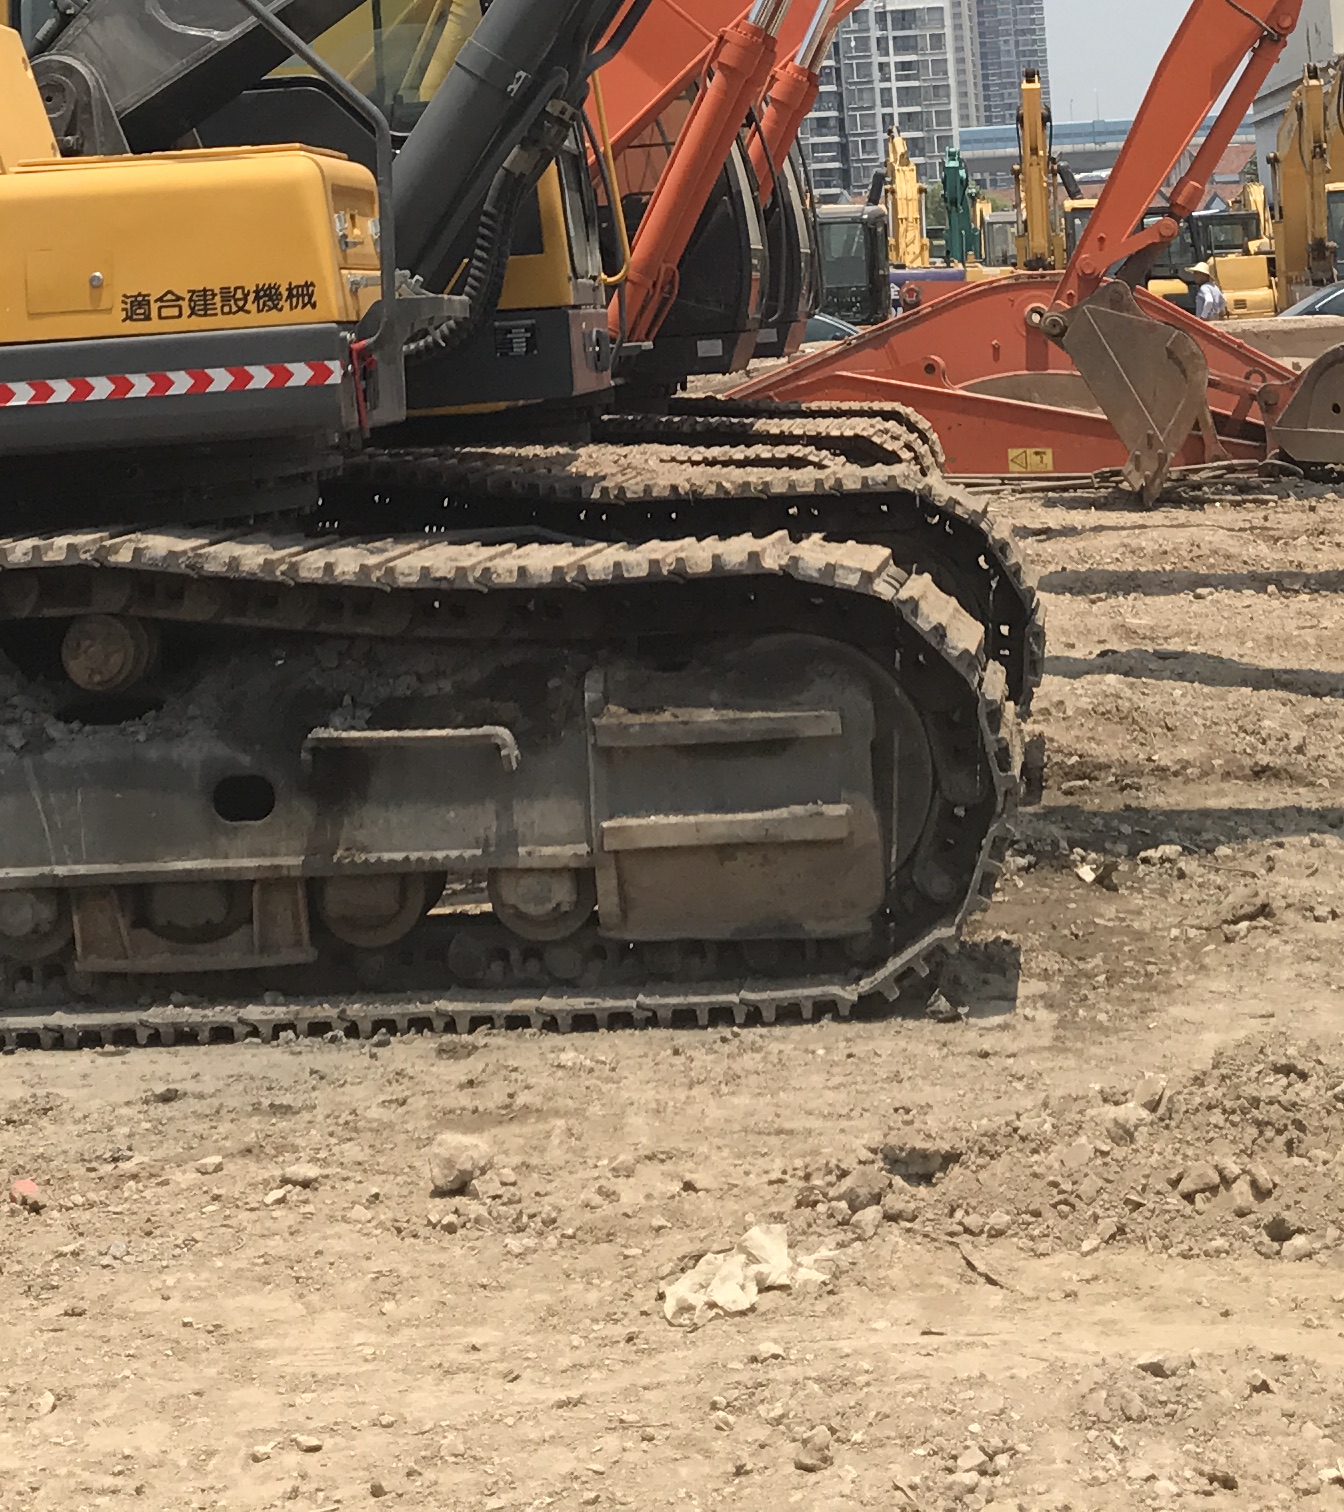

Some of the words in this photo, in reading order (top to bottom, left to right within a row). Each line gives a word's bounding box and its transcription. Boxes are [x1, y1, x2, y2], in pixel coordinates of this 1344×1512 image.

[121, 280, 317, 323] 適合建設機械
